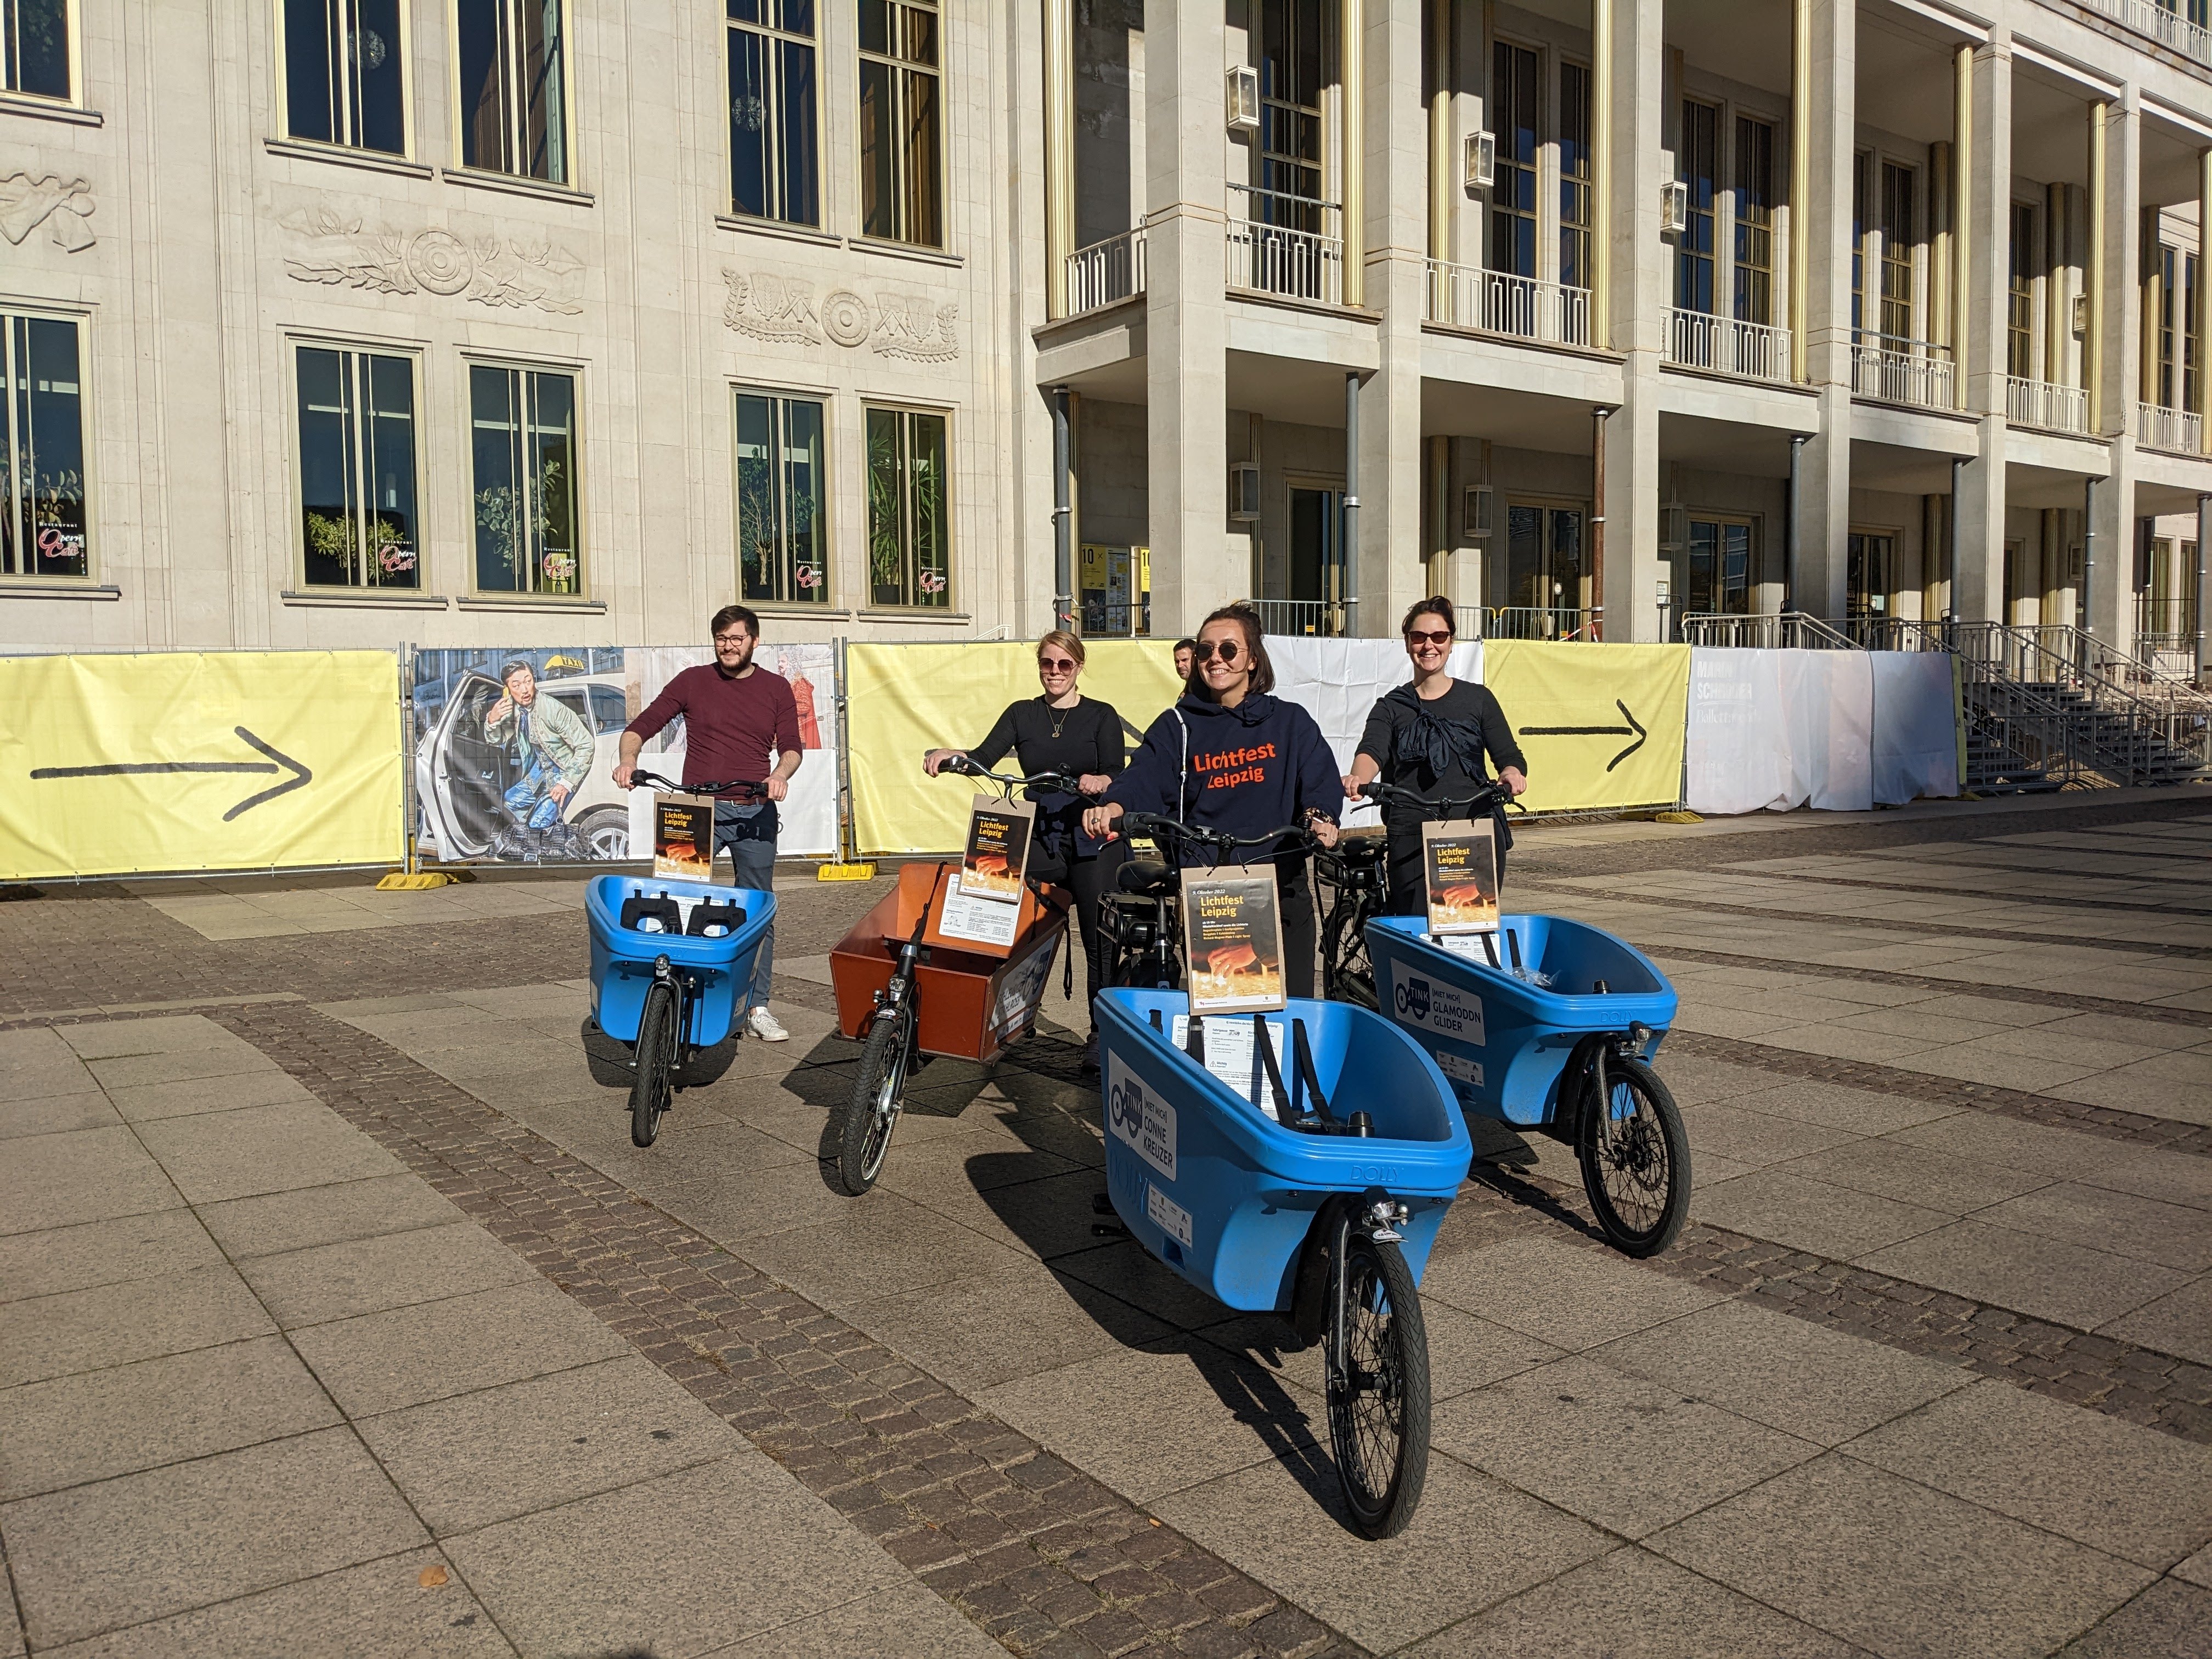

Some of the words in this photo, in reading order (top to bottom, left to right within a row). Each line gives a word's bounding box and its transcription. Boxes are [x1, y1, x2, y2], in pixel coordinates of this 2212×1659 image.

[1082, 548, 1094, 565] 10
[561, 657, 582, 668] TAXI
[1195, 743, 1276, 772] Lichtfest
[1207, 766, 1265, 789] Leipzig
[665, 812, 692, 820] Lichtfest
[664, 819, 687, 827] Leipzig
[980, 821, 1009, 831] Lichtfest
[979, 828, 1003, 838] Leipzig
[1437, 848, 1470, 856] Lichtfest
[1437, 856, 1465, 865] Leipzig
[1200, 895, 1244, 906] Lichtfest
[1201, 906, 1237, 918] Leipzig
[1410, 987, 1429, 1002] TINK
[1433, 1001, 1481, 1023] GLAMODDN
[1600, 1011, 1636, 1022] DOLLY
[1434, 1015, 1463, 1032] GLIDER
[1126, 1091, 1142, 1116] TINK
[1144, 1115, 1166, 1144] CONNE
[1143, 1135, 1173, 1169] KREUZER
[1351, 1165, 1404, 1183] DOLLY
